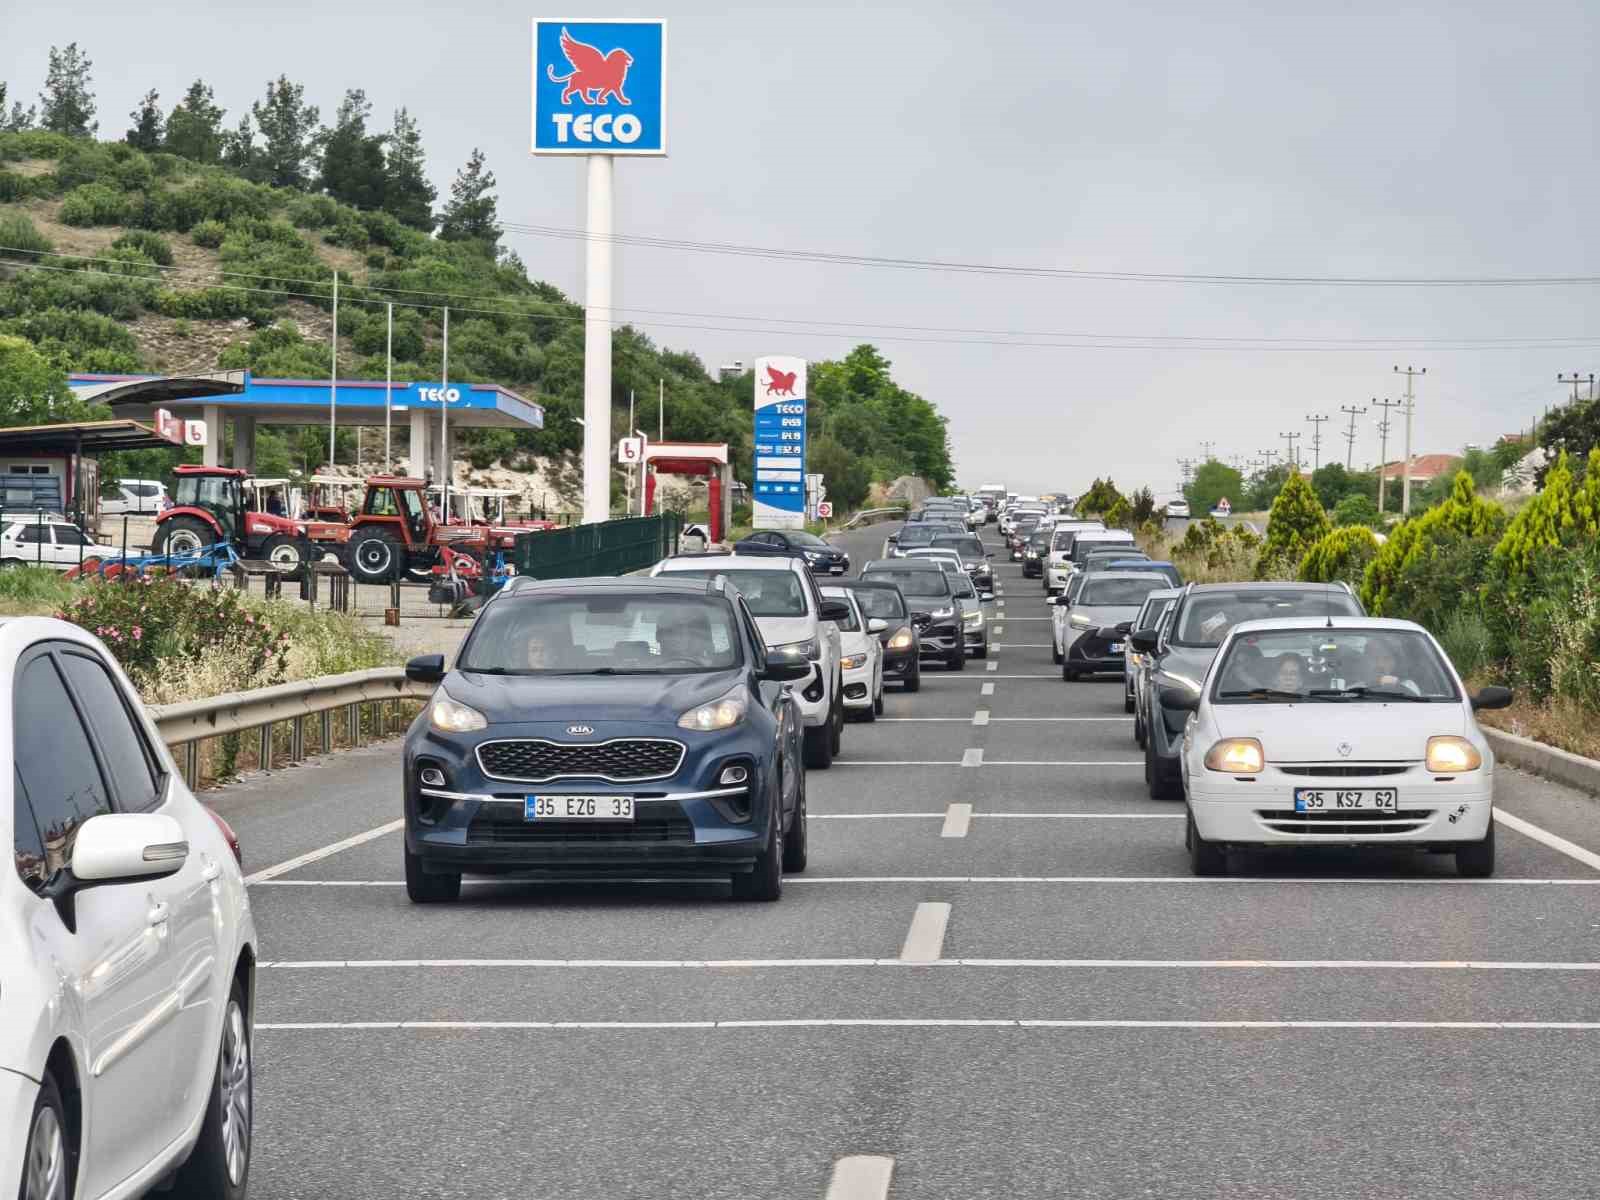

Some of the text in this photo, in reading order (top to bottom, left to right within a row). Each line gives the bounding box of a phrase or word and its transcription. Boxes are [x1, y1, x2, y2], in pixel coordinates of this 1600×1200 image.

[552, 113, 642, 143] TECO
[418, 388, 460, 402] TECO
[776, 404, 803, 414] TECO
[569, 725, 591, 734] KIA
[1307, 792, 1392, 807] 35 KSZ 62
[536, 799, 554, 815] 35
[567, 799, 595, 815] EZG
[612, 799, 631, 815] 33
